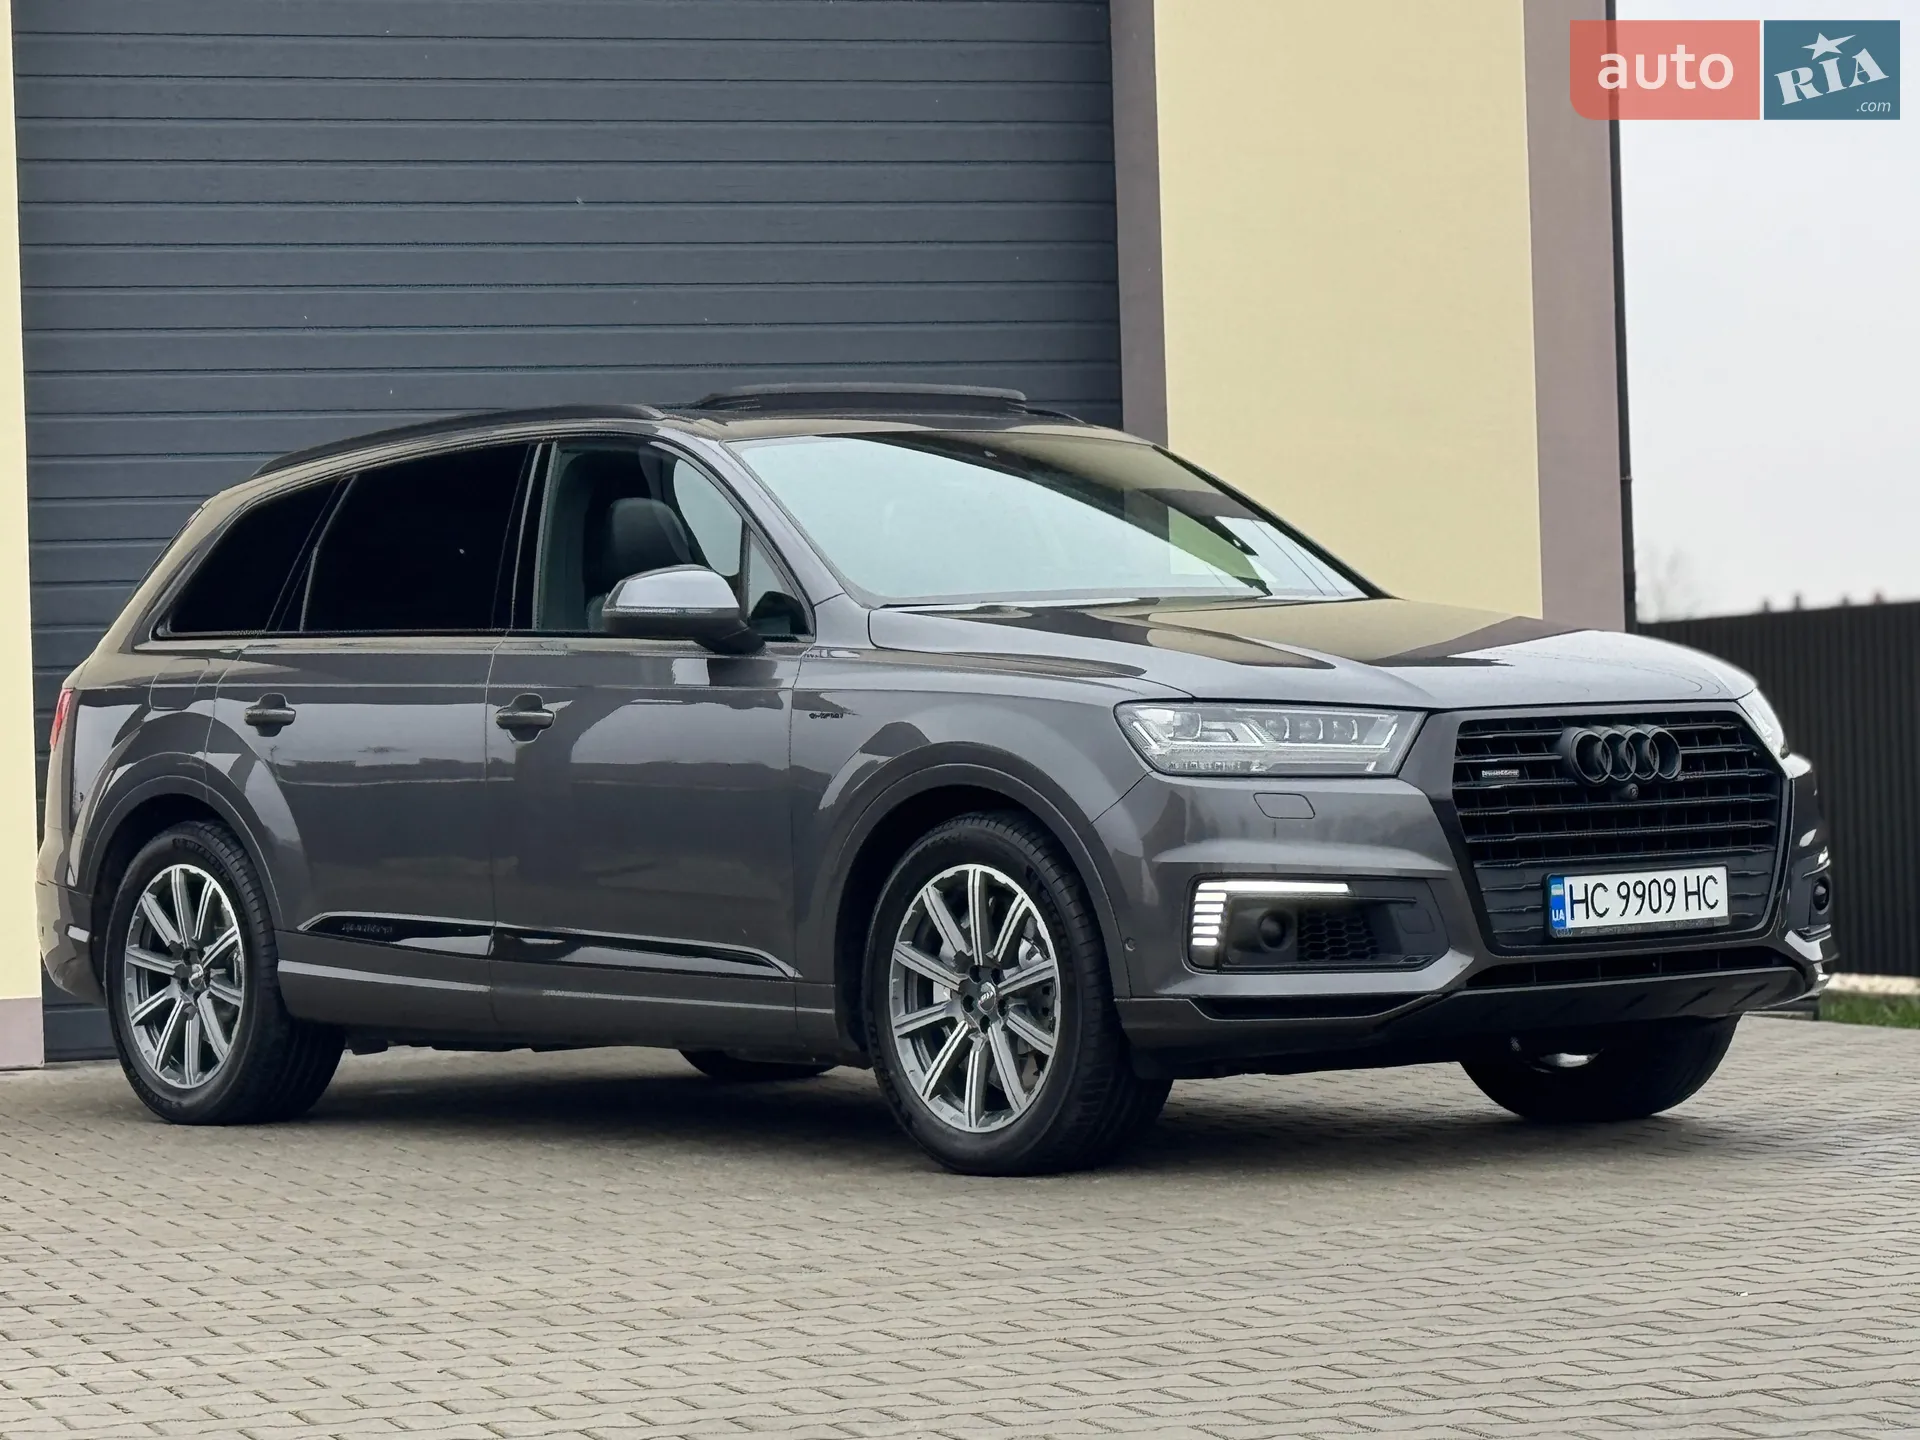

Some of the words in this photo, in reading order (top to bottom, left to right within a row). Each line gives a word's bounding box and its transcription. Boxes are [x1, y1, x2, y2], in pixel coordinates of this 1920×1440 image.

[1569, 882, 1610, 921] HC
[1616, 877, 1677, 917] 9909
[1684, 874, 1719, 912] HC
[1551, 908, 1566, 922] UA
